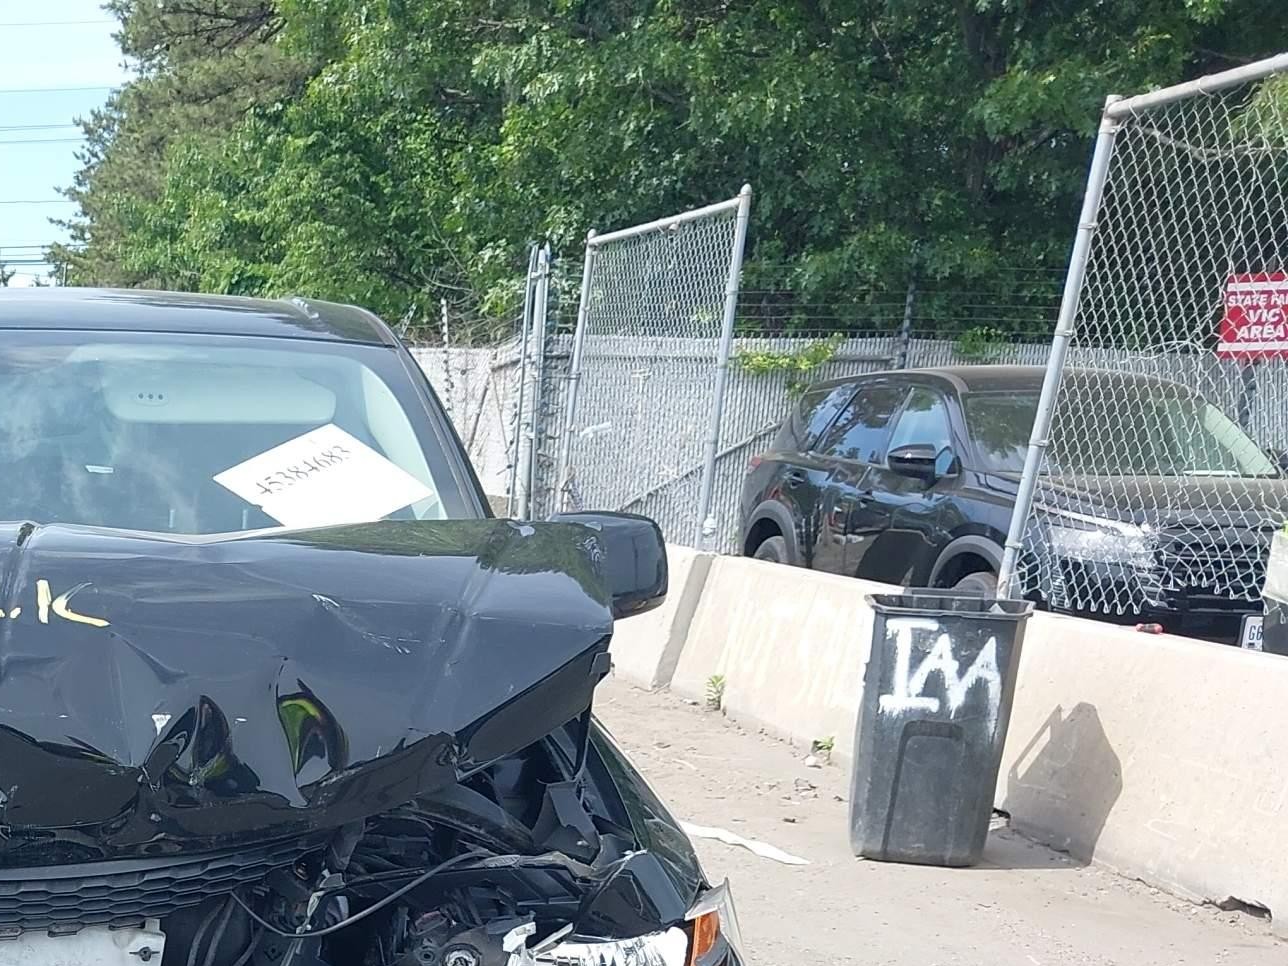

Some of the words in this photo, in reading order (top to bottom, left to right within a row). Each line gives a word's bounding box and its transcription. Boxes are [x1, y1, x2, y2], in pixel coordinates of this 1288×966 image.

[1228, 293, 1268, 306] STATE
[1248, 308, 1281, 322] VIC
[1236, 323, 1285, 340] AREA
[255, 444, 351, 495] 45384683
[877, 617, 1003, 738] IAA
